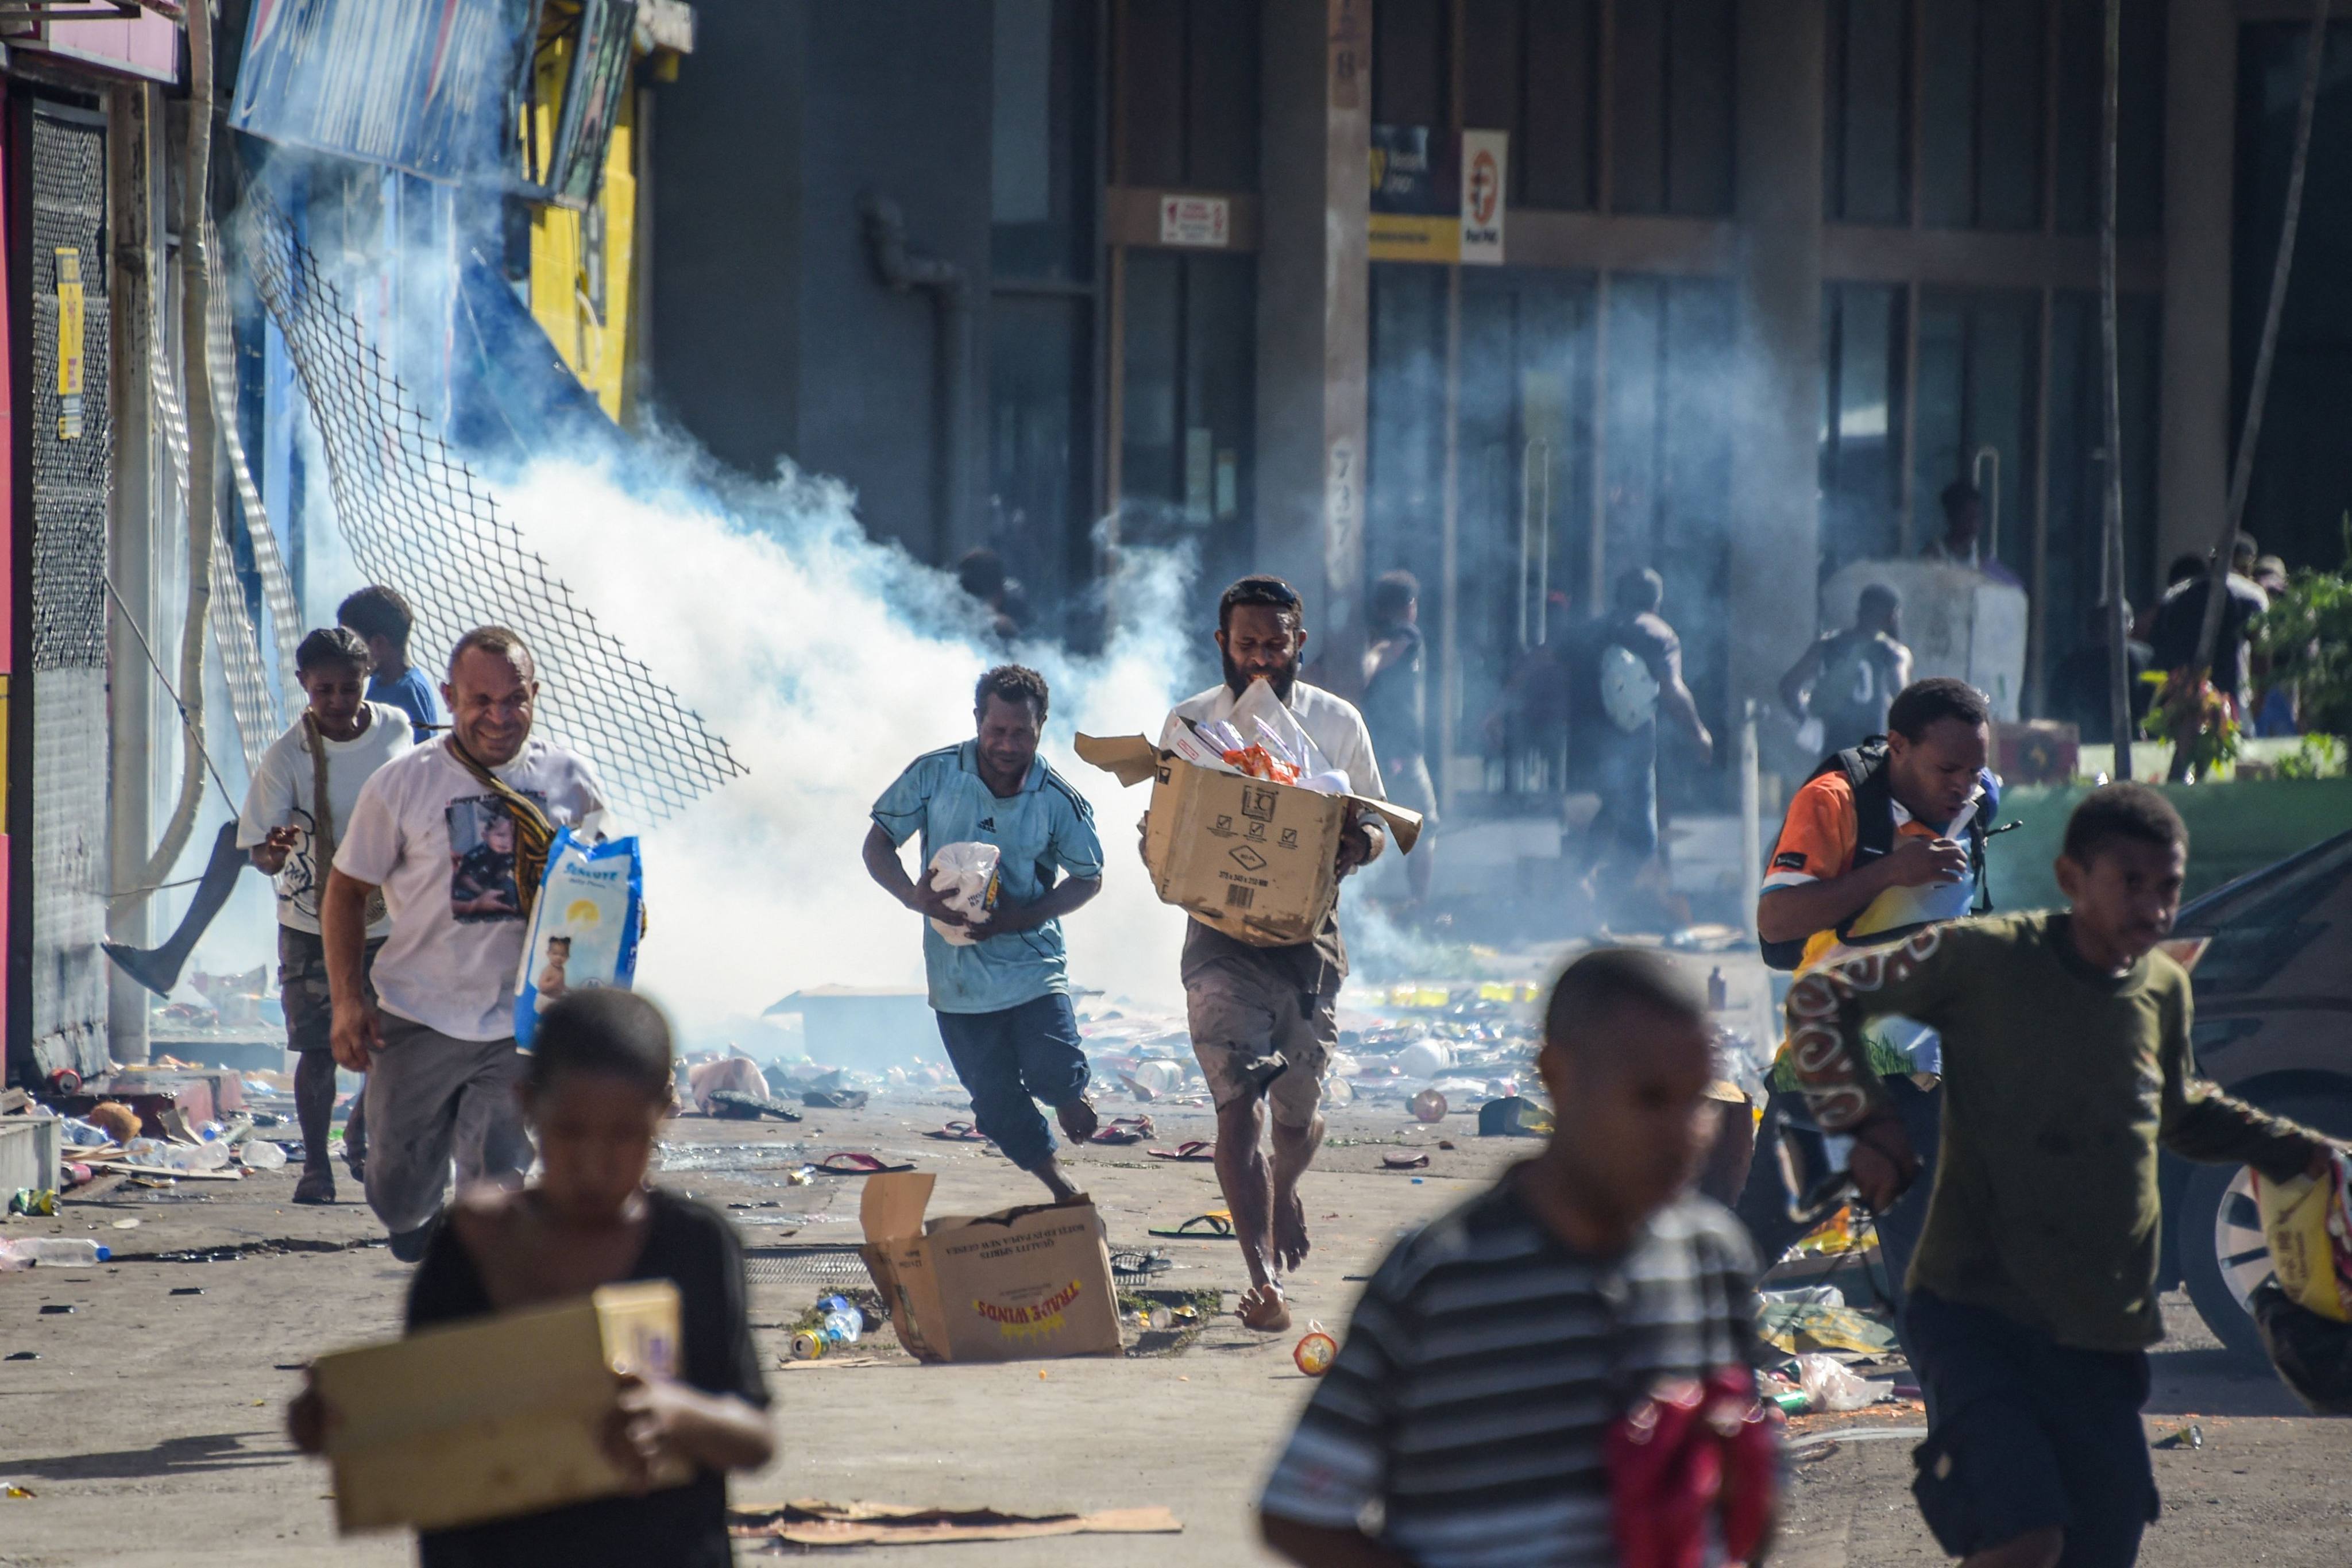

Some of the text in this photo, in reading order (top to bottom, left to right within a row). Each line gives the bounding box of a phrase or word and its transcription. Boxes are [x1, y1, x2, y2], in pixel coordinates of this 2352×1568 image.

[981, 1239, 1003, 1249] NEW
[1003, 1233, 1032, 1245] PAPUA
[946, 1243, 979, 1255] GUINEA
[979, 1238, 1056, 1260] QUALITY SPIRITS
[1032, 1281, 1080, 1321] TRADE
[978, 1300, 1030, 1324] WINDS
